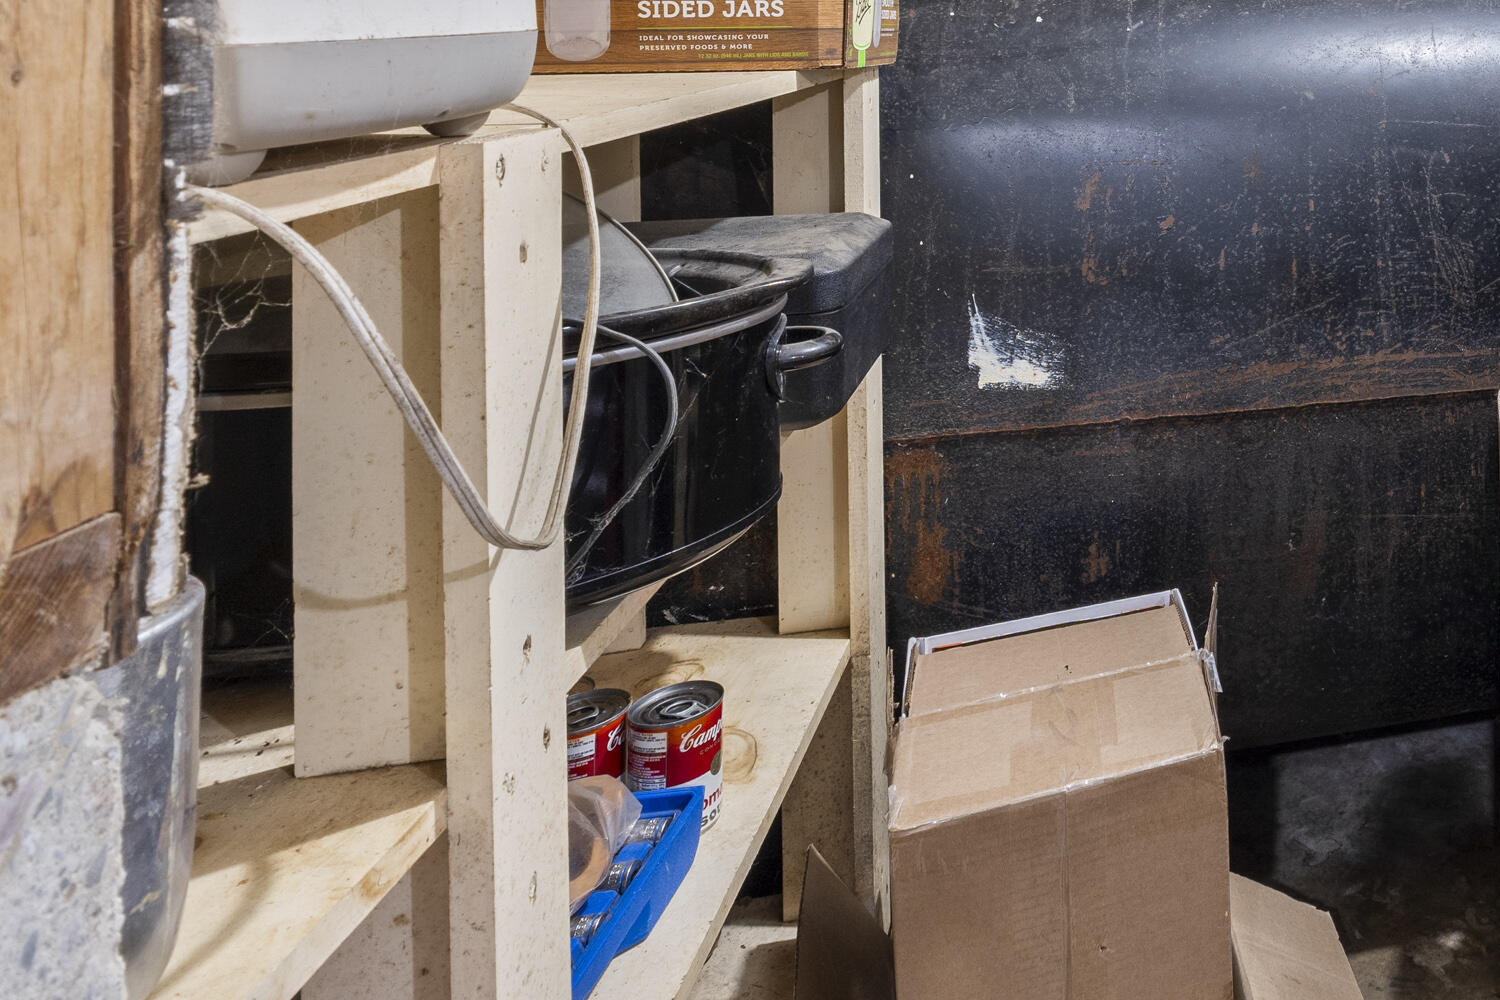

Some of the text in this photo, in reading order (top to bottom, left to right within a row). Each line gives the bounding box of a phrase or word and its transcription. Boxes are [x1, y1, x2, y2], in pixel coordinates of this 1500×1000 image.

[637, 0, 785, 18] SIDED JARS
[679, 719, 722, 753] Camp
